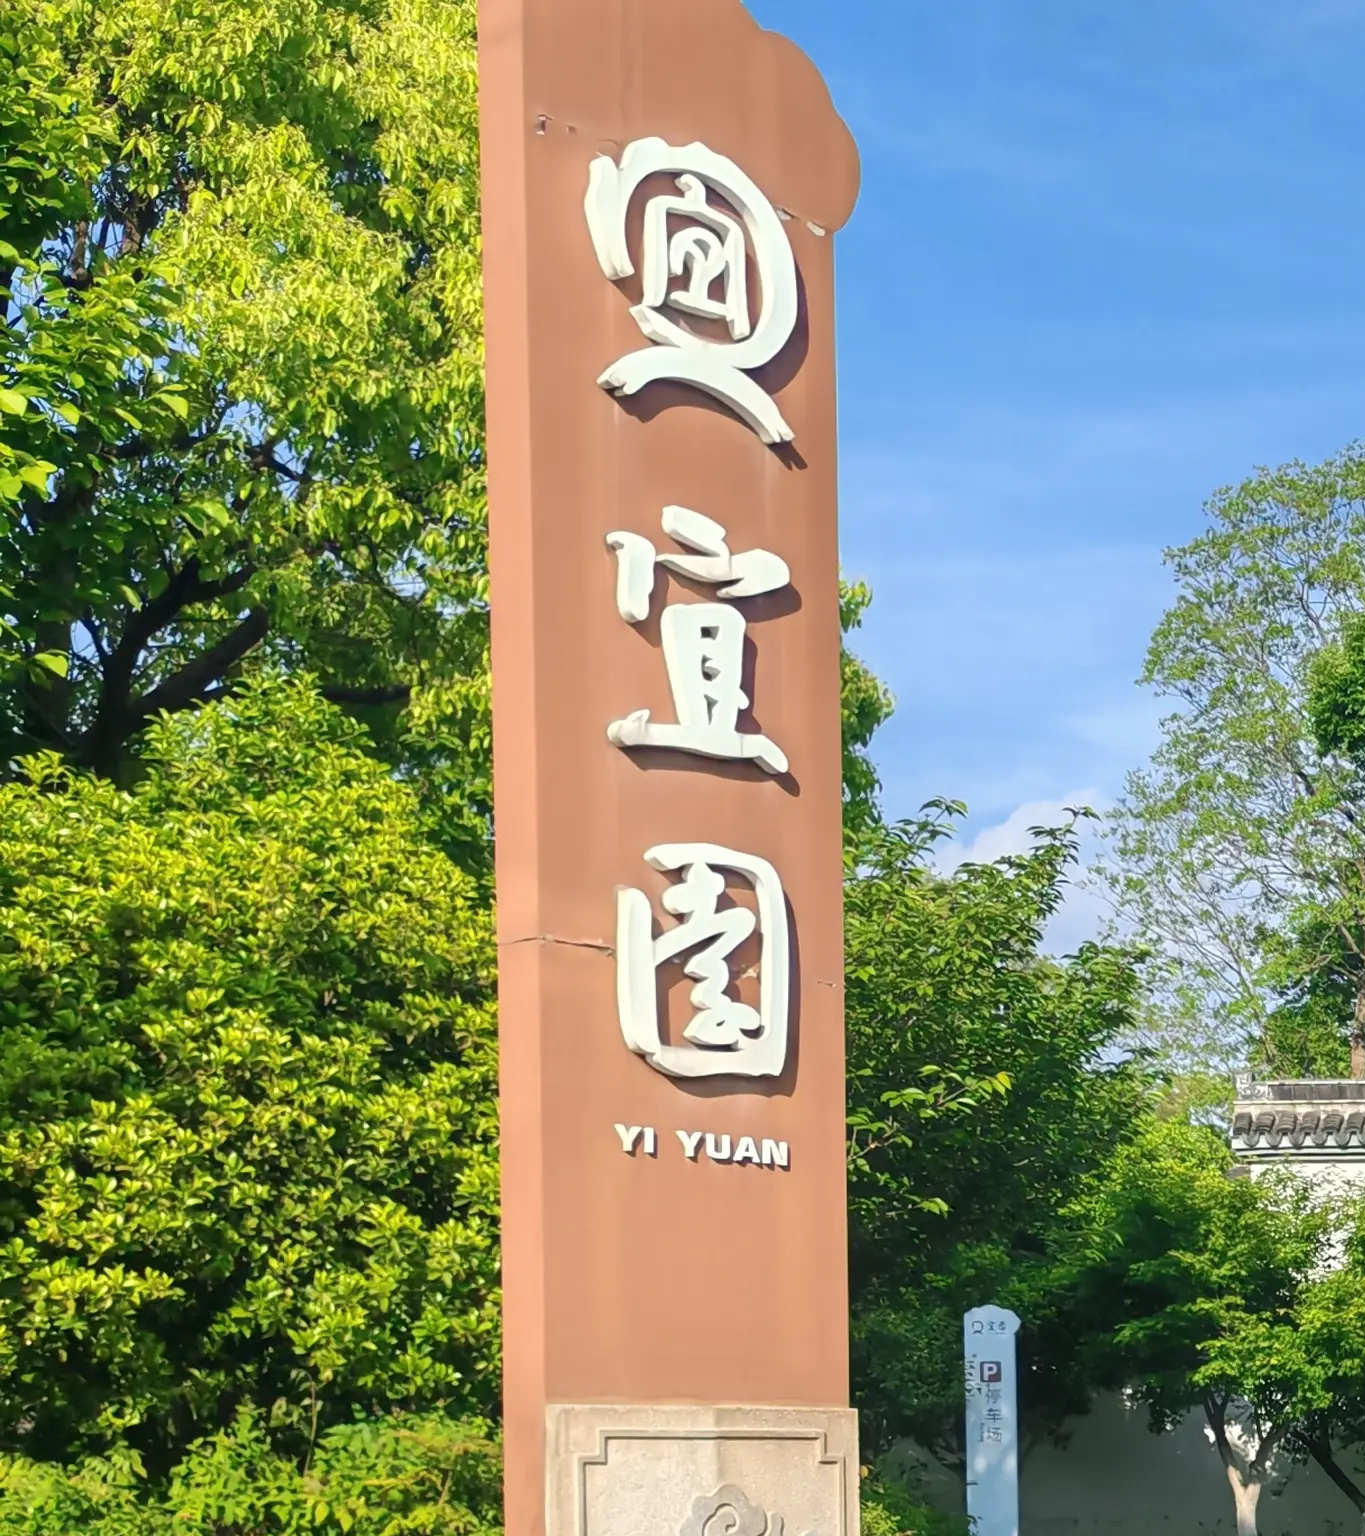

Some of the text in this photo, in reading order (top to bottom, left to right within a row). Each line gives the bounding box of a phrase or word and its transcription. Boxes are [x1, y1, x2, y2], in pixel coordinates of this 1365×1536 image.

[613, 1122, 789, 1167] YI YUAN
[982, 1362, 998, 1382] P
[984, 1384, 1004, 1443] 停车场
